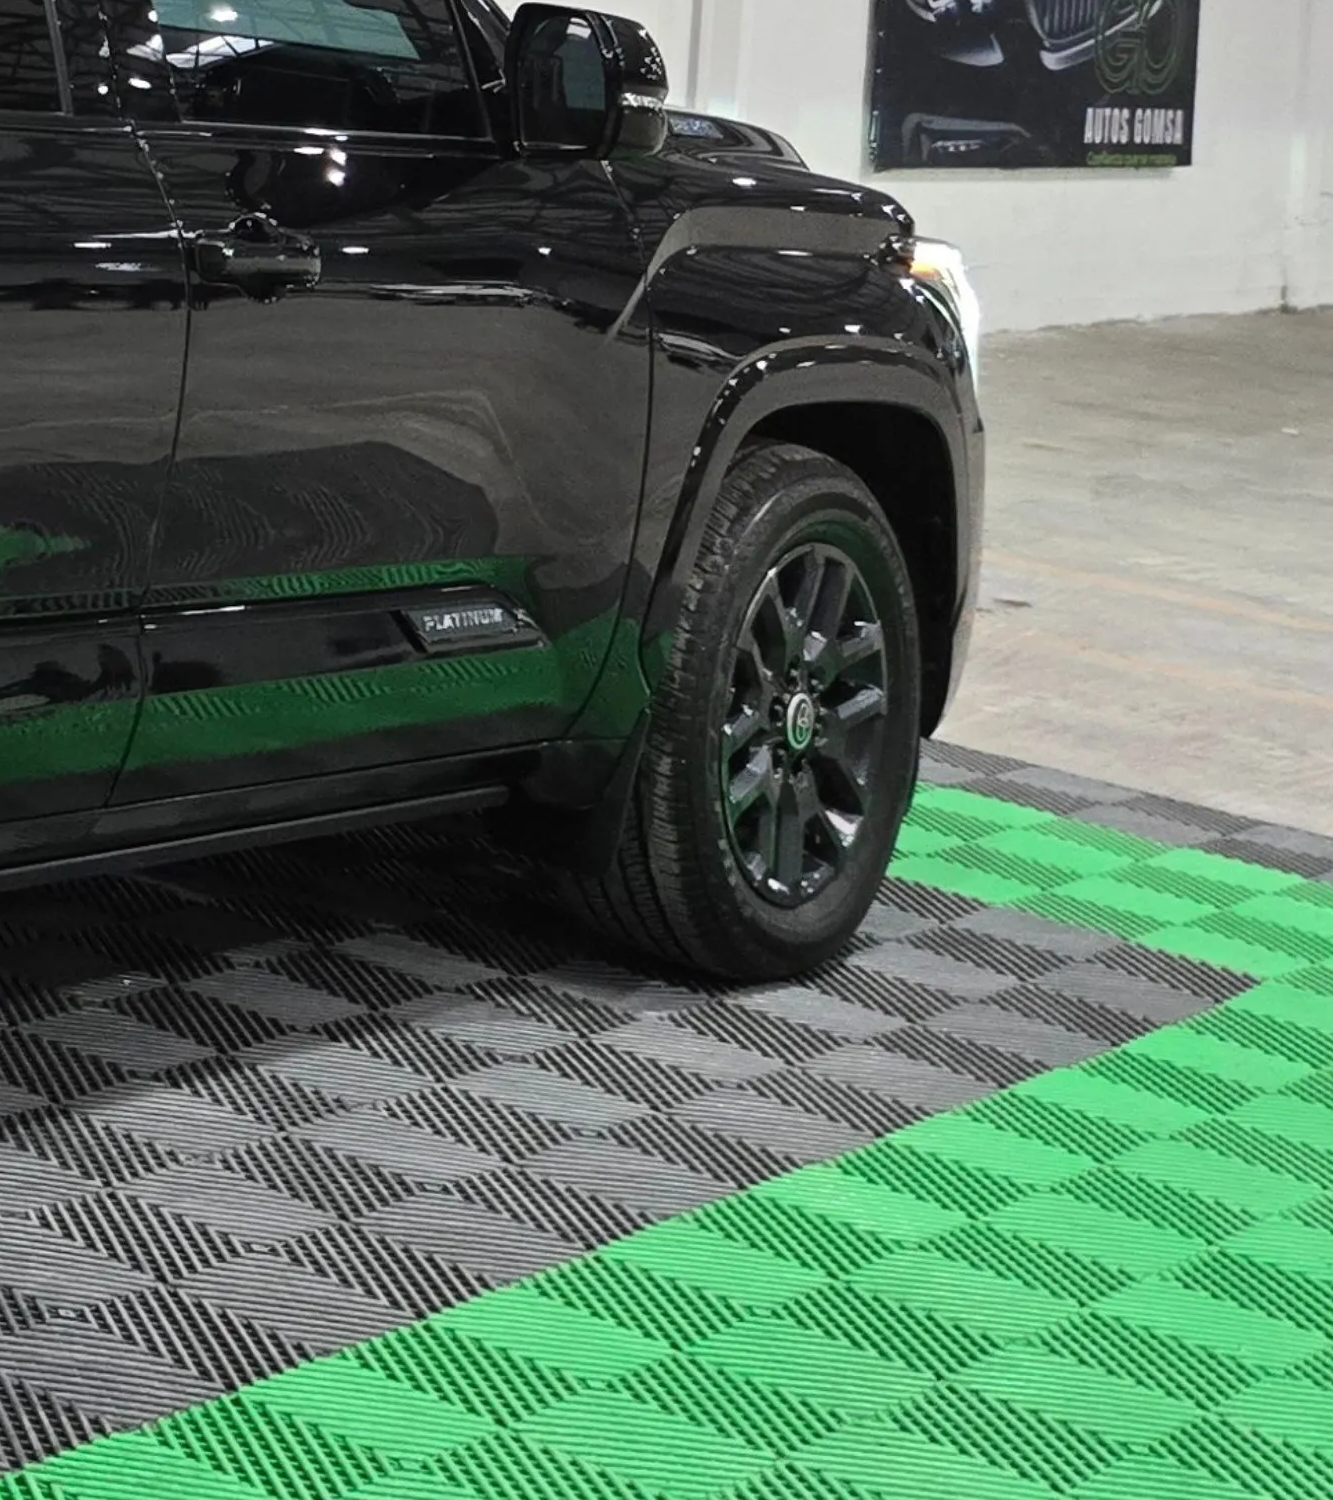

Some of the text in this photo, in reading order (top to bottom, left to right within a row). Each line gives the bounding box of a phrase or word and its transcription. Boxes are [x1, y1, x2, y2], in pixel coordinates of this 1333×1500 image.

[1083, 106, 1184, 146] AUTOS GOMSA
[422, 607, 504, 632] PLATINUM
